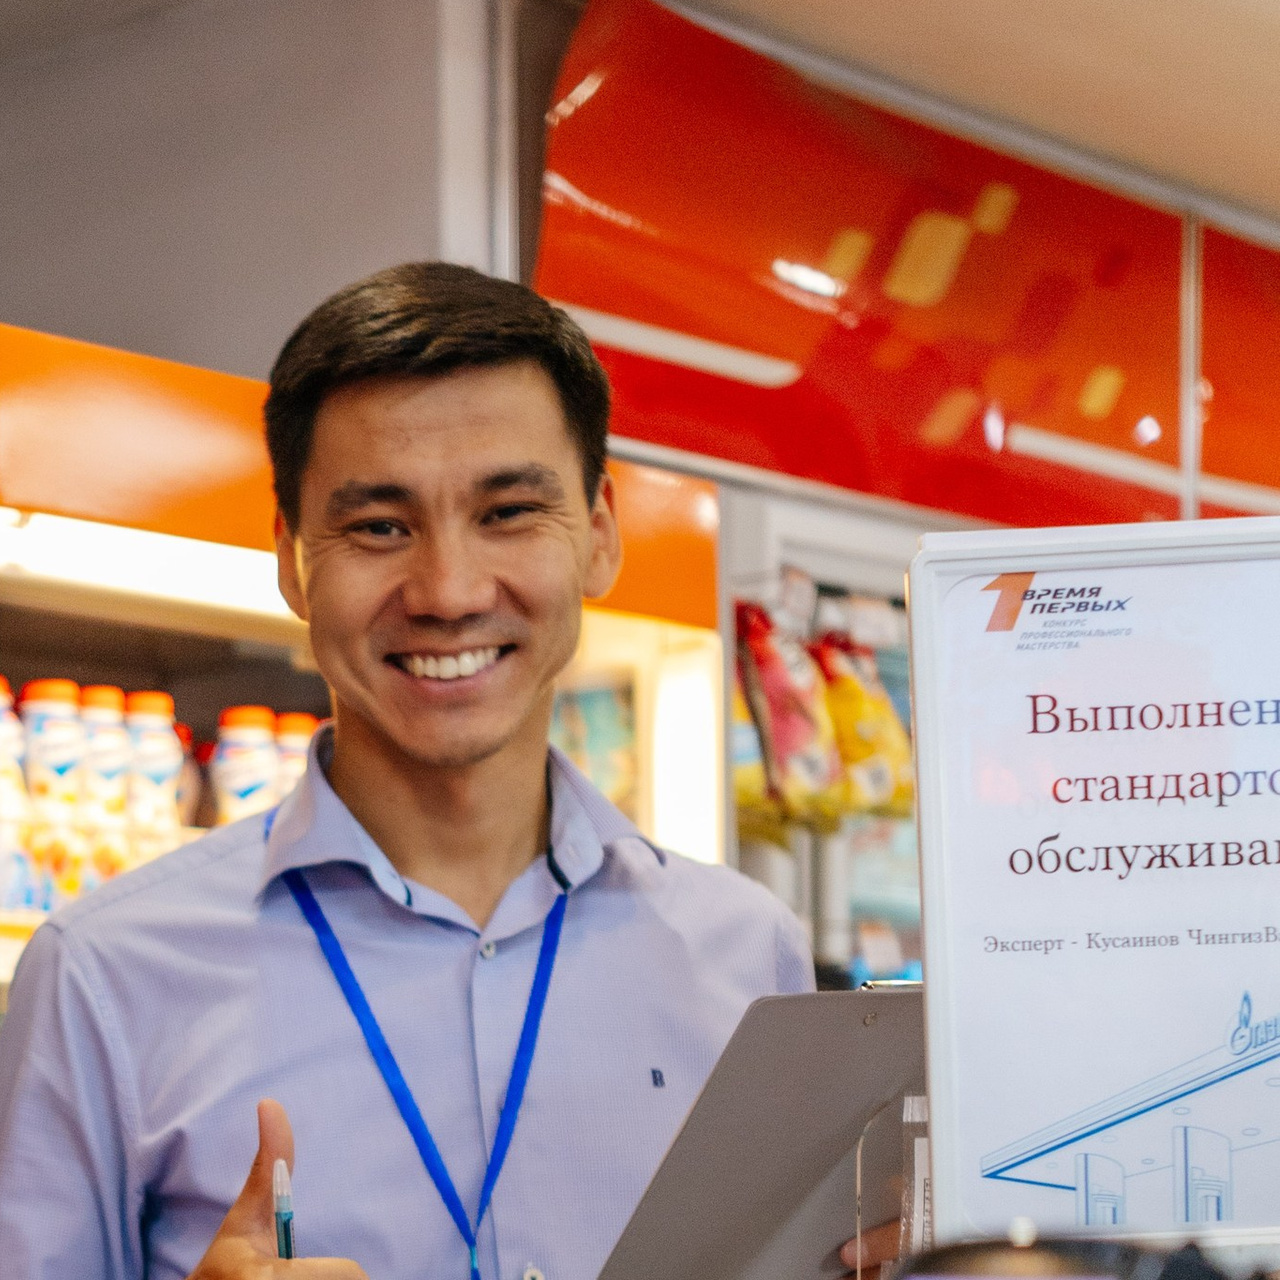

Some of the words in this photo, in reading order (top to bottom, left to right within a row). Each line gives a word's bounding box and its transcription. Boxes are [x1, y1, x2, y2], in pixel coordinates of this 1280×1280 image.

[1022, 586, 1102, 601] ВРЕМЯ
[1030, 597, 1133, 614] ПЕРВЫХ
[1026, 694, 1280, 735] Выполнен
[1008, 833, 1280, 880] обслужива
[983, 934, 1064, 954] Эксперт
[1086, 932, 1179, 952] Кусаинов
[1188, 927, 1280, 947] ЧингизВ
